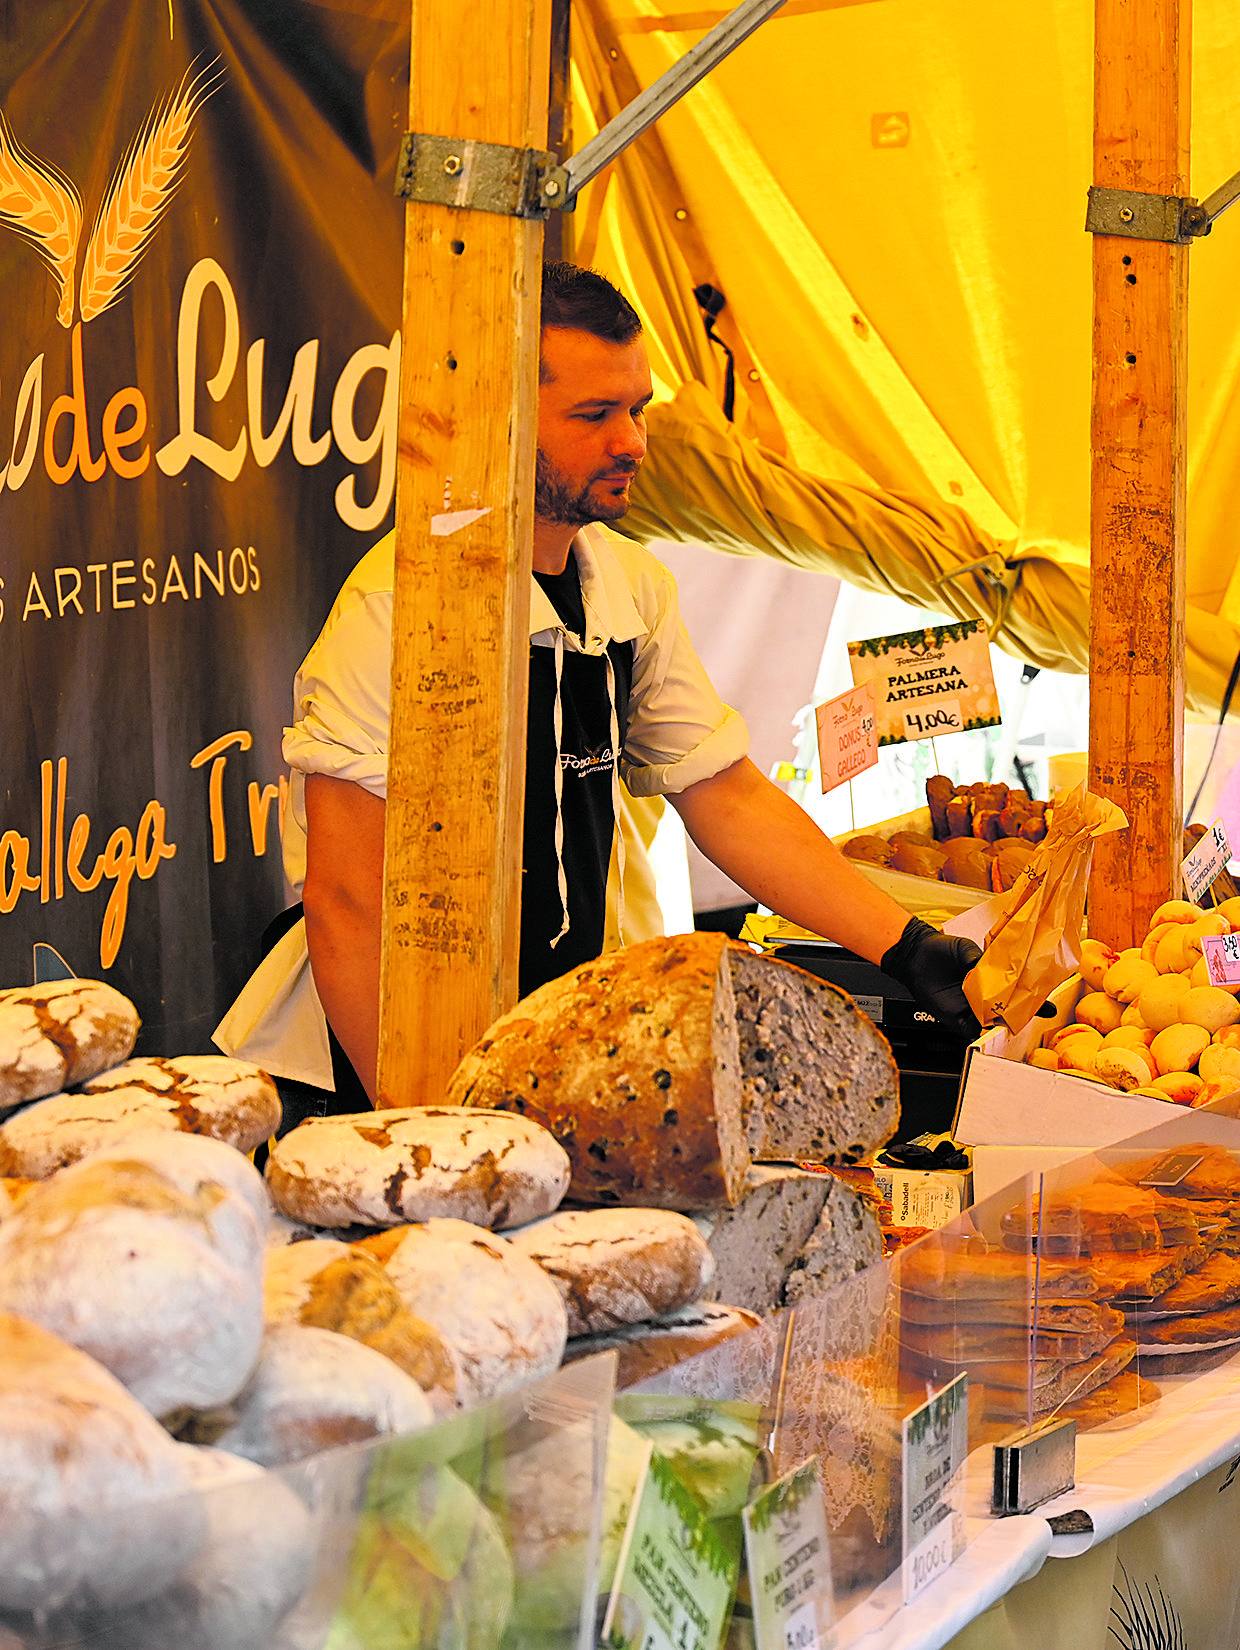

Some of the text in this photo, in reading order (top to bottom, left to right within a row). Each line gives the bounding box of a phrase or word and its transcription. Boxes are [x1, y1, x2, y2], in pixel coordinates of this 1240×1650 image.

[155, 257, 402, 531] Lug
[22, 546, 261, 622] ARTESANOS
[886, 678, 969, 702] ARTESANA
[888, 665, 961, 687] PALMERA
[837, 748, 866, 778] GALLEGO
[0, 757, 177, 970] allega
[902, 1182, 910, 1216] Sabadell
